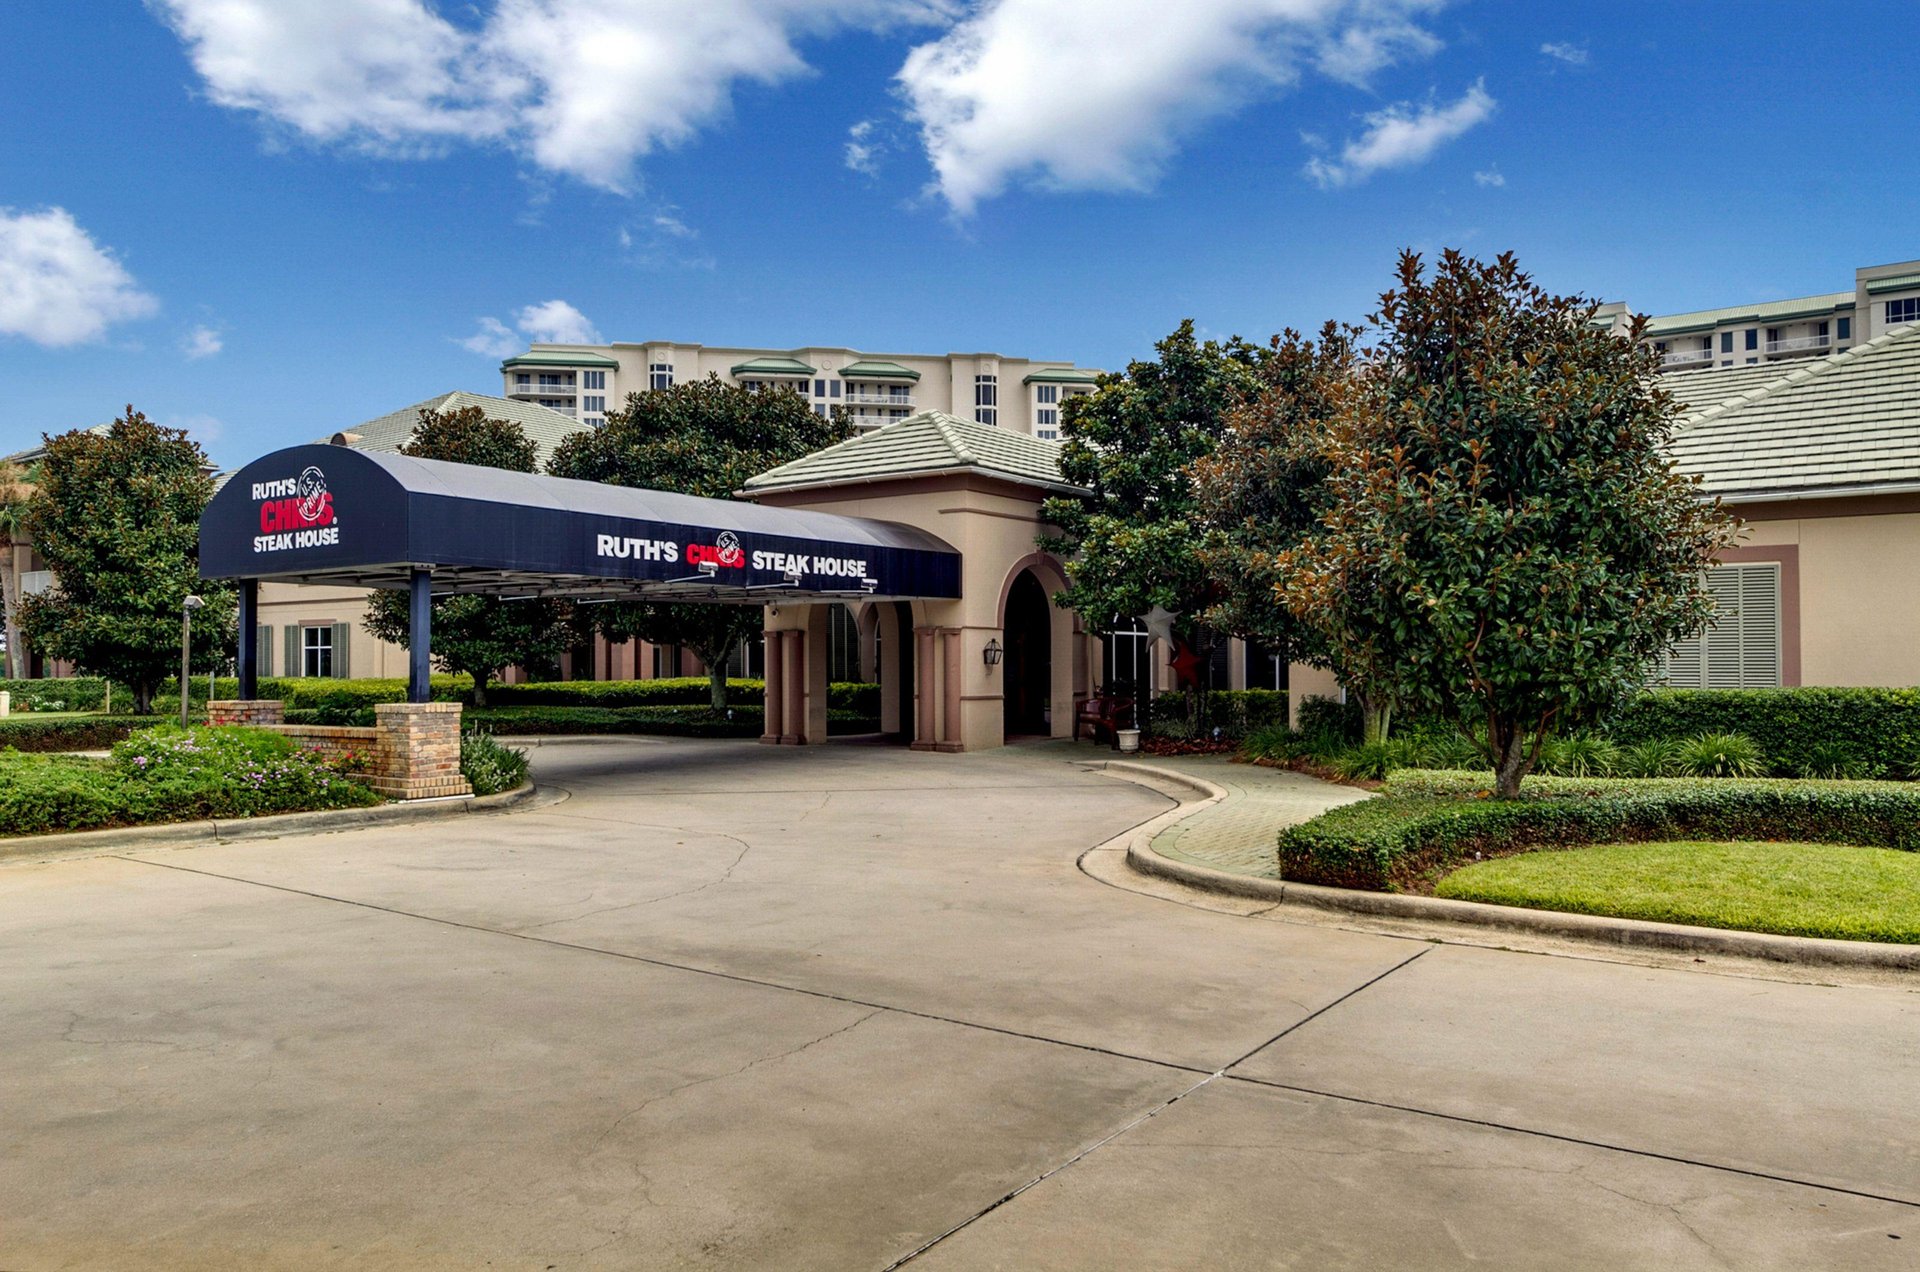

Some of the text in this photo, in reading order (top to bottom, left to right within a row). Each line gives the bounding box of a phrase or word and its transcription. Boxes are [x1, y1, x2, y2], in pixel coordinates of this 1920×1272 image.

[252, 478, 297, 500] RUTH'S
[303, 481, 323, 514] PRIME
[253, 527, 339, 553] STEAK HOUSE
[597, 533, 679, 563] RUTH'S
[752, 550, 810, 575] STEAK
[813, 556, 867, 578] HOUSE
